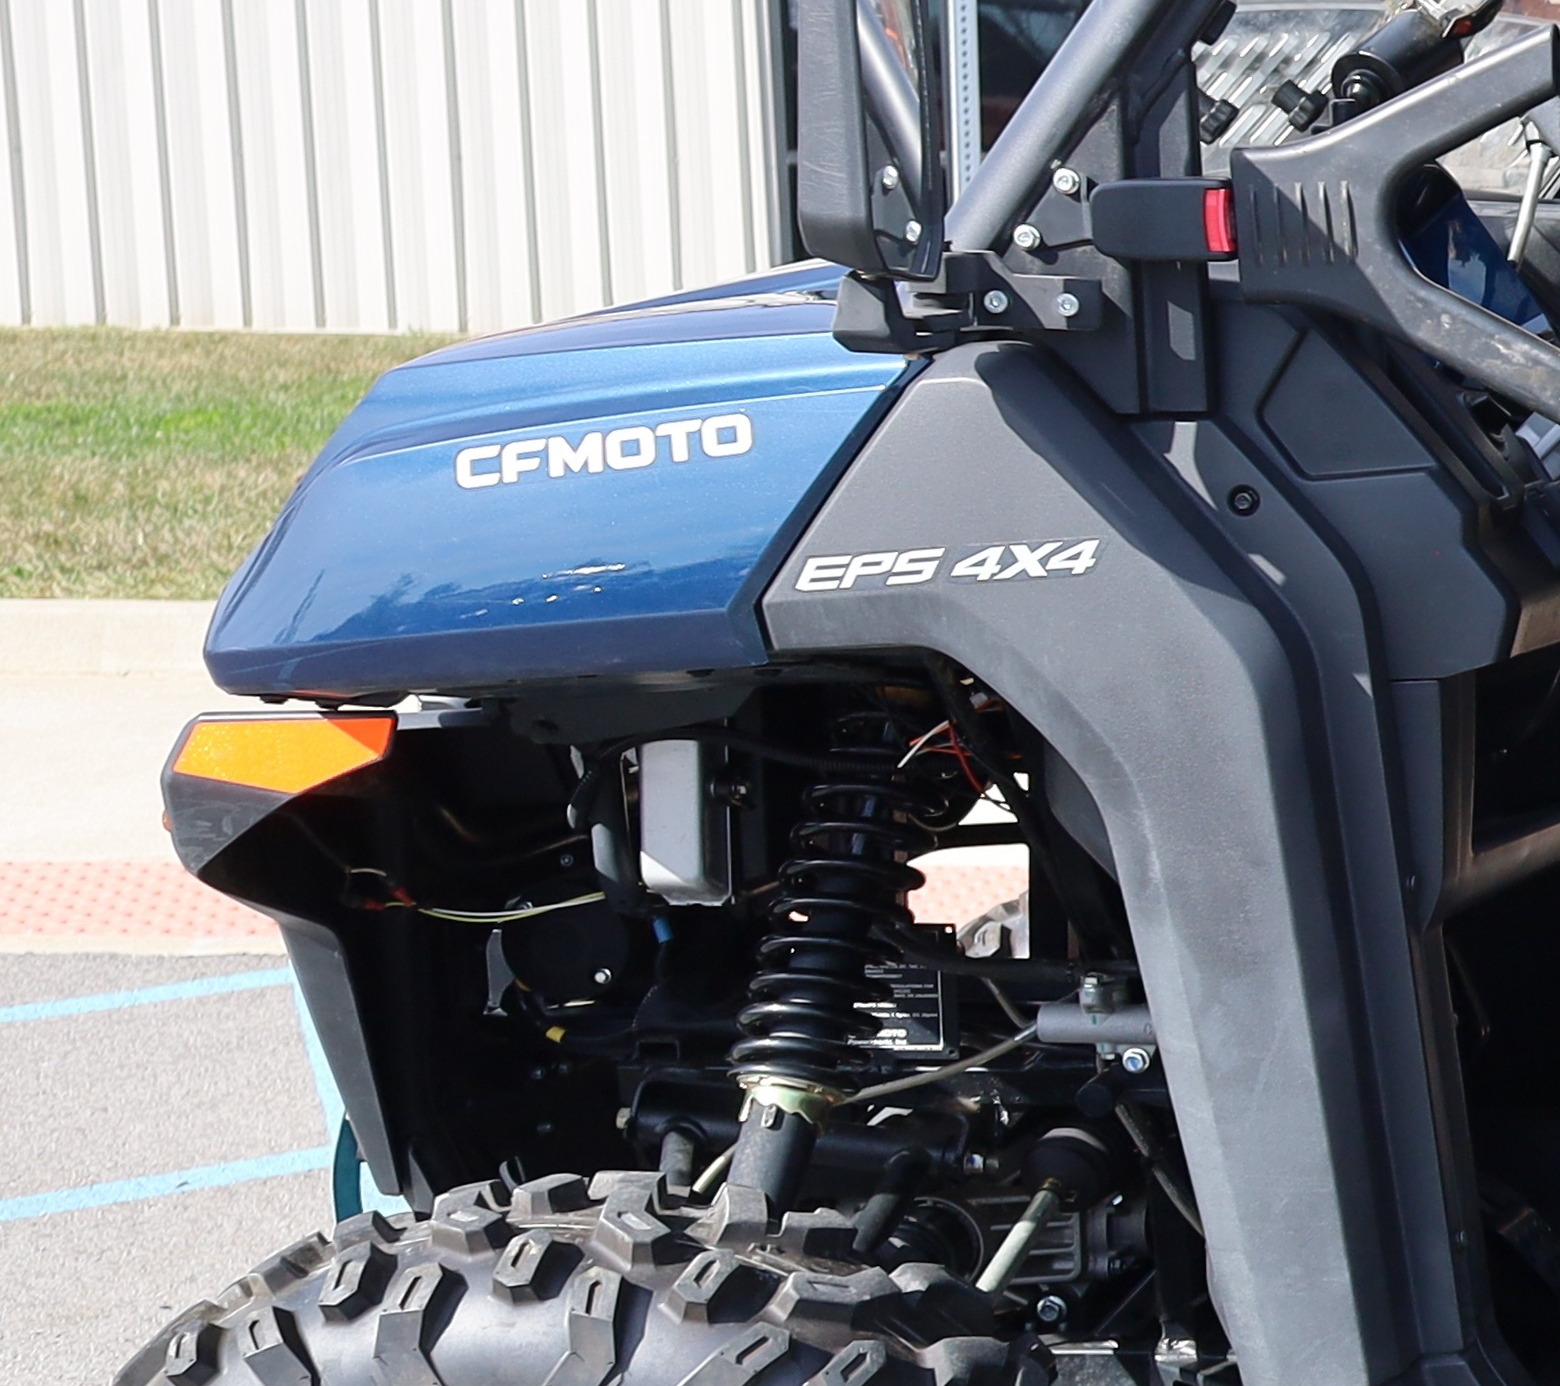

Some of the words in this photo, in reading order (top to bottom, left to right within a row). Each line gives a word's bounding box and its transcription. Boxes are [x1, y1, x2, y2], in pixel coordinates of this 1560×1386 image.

[455, 412, 753, 490] CFMOTO
[795, 546, 946, 592] EPS
[949, 538, 1101, 583] 4X4
